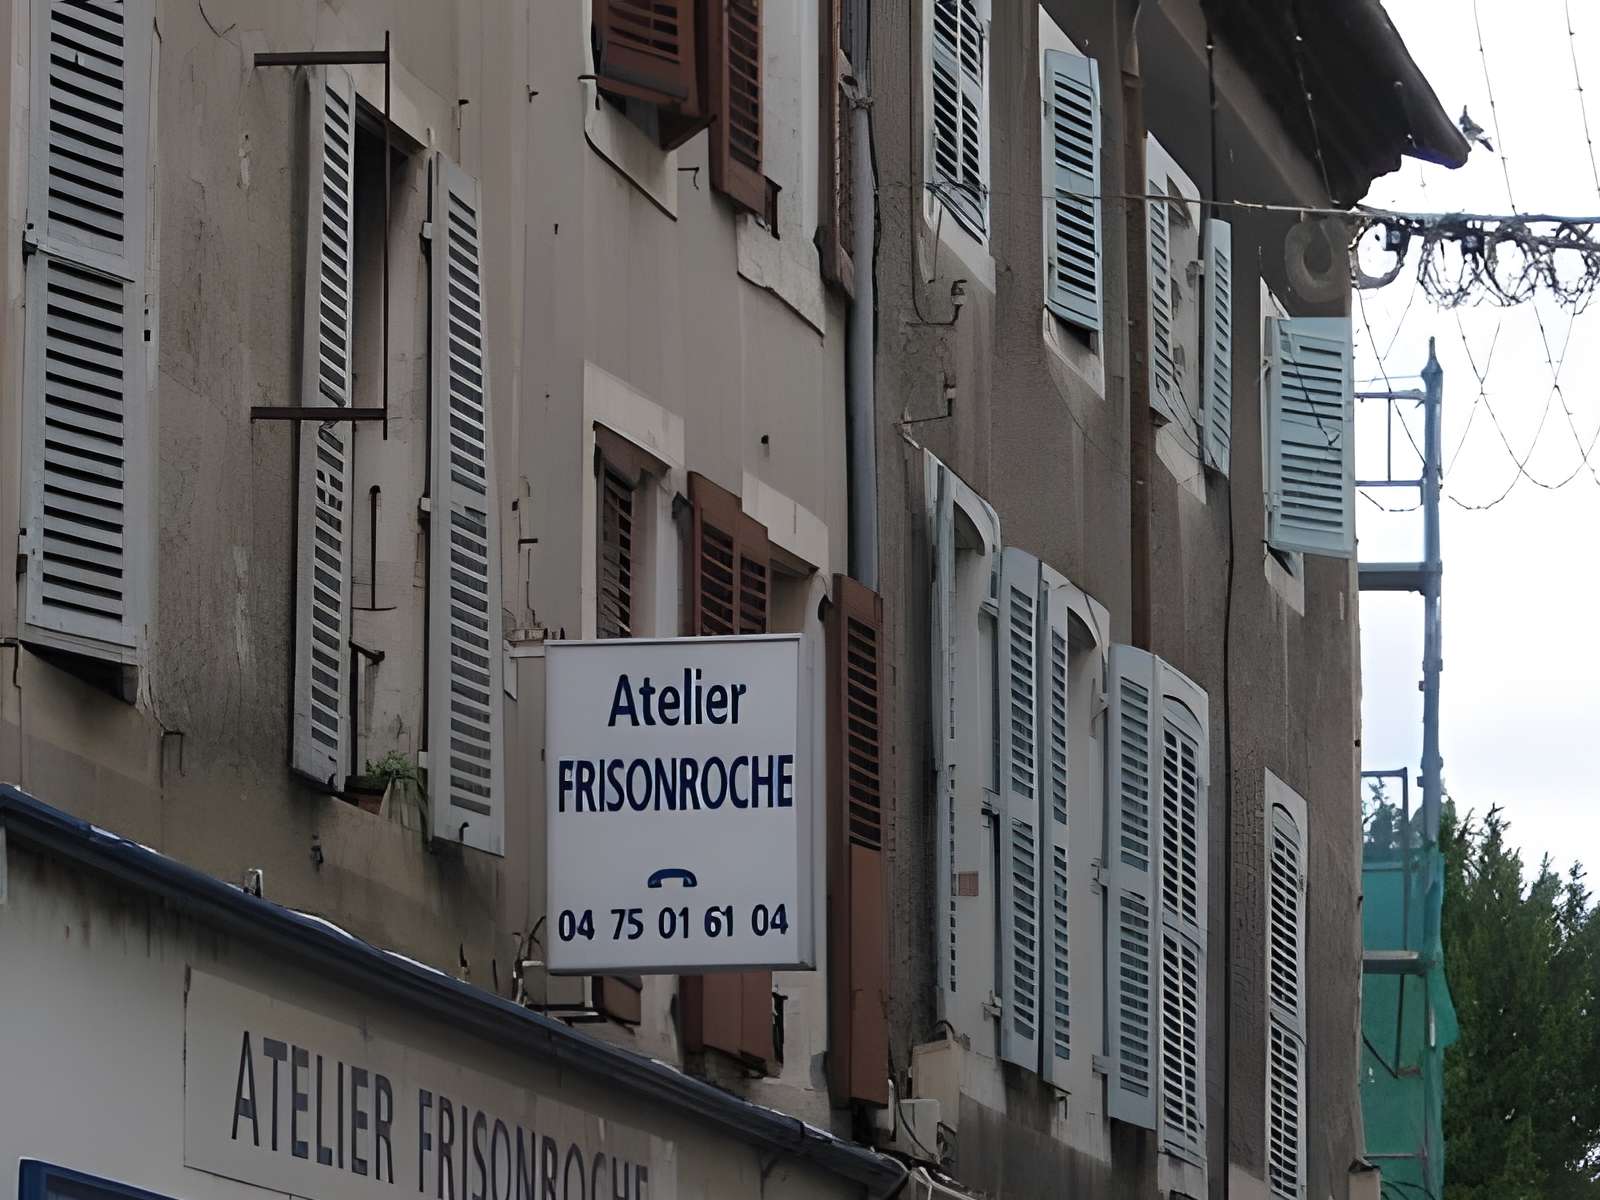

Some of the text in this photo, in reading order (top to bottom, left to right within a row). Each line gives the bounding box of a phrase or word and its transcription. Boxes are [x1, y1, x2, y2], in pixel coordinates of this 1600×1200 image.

[608, 667, 747, 727] Atelier
[558, 754, 793, 812] FRISONROCHE
[558, 903, 789, 942] 04 75 01 61 04
[232, 1031, 394, 1184] ATELIER
